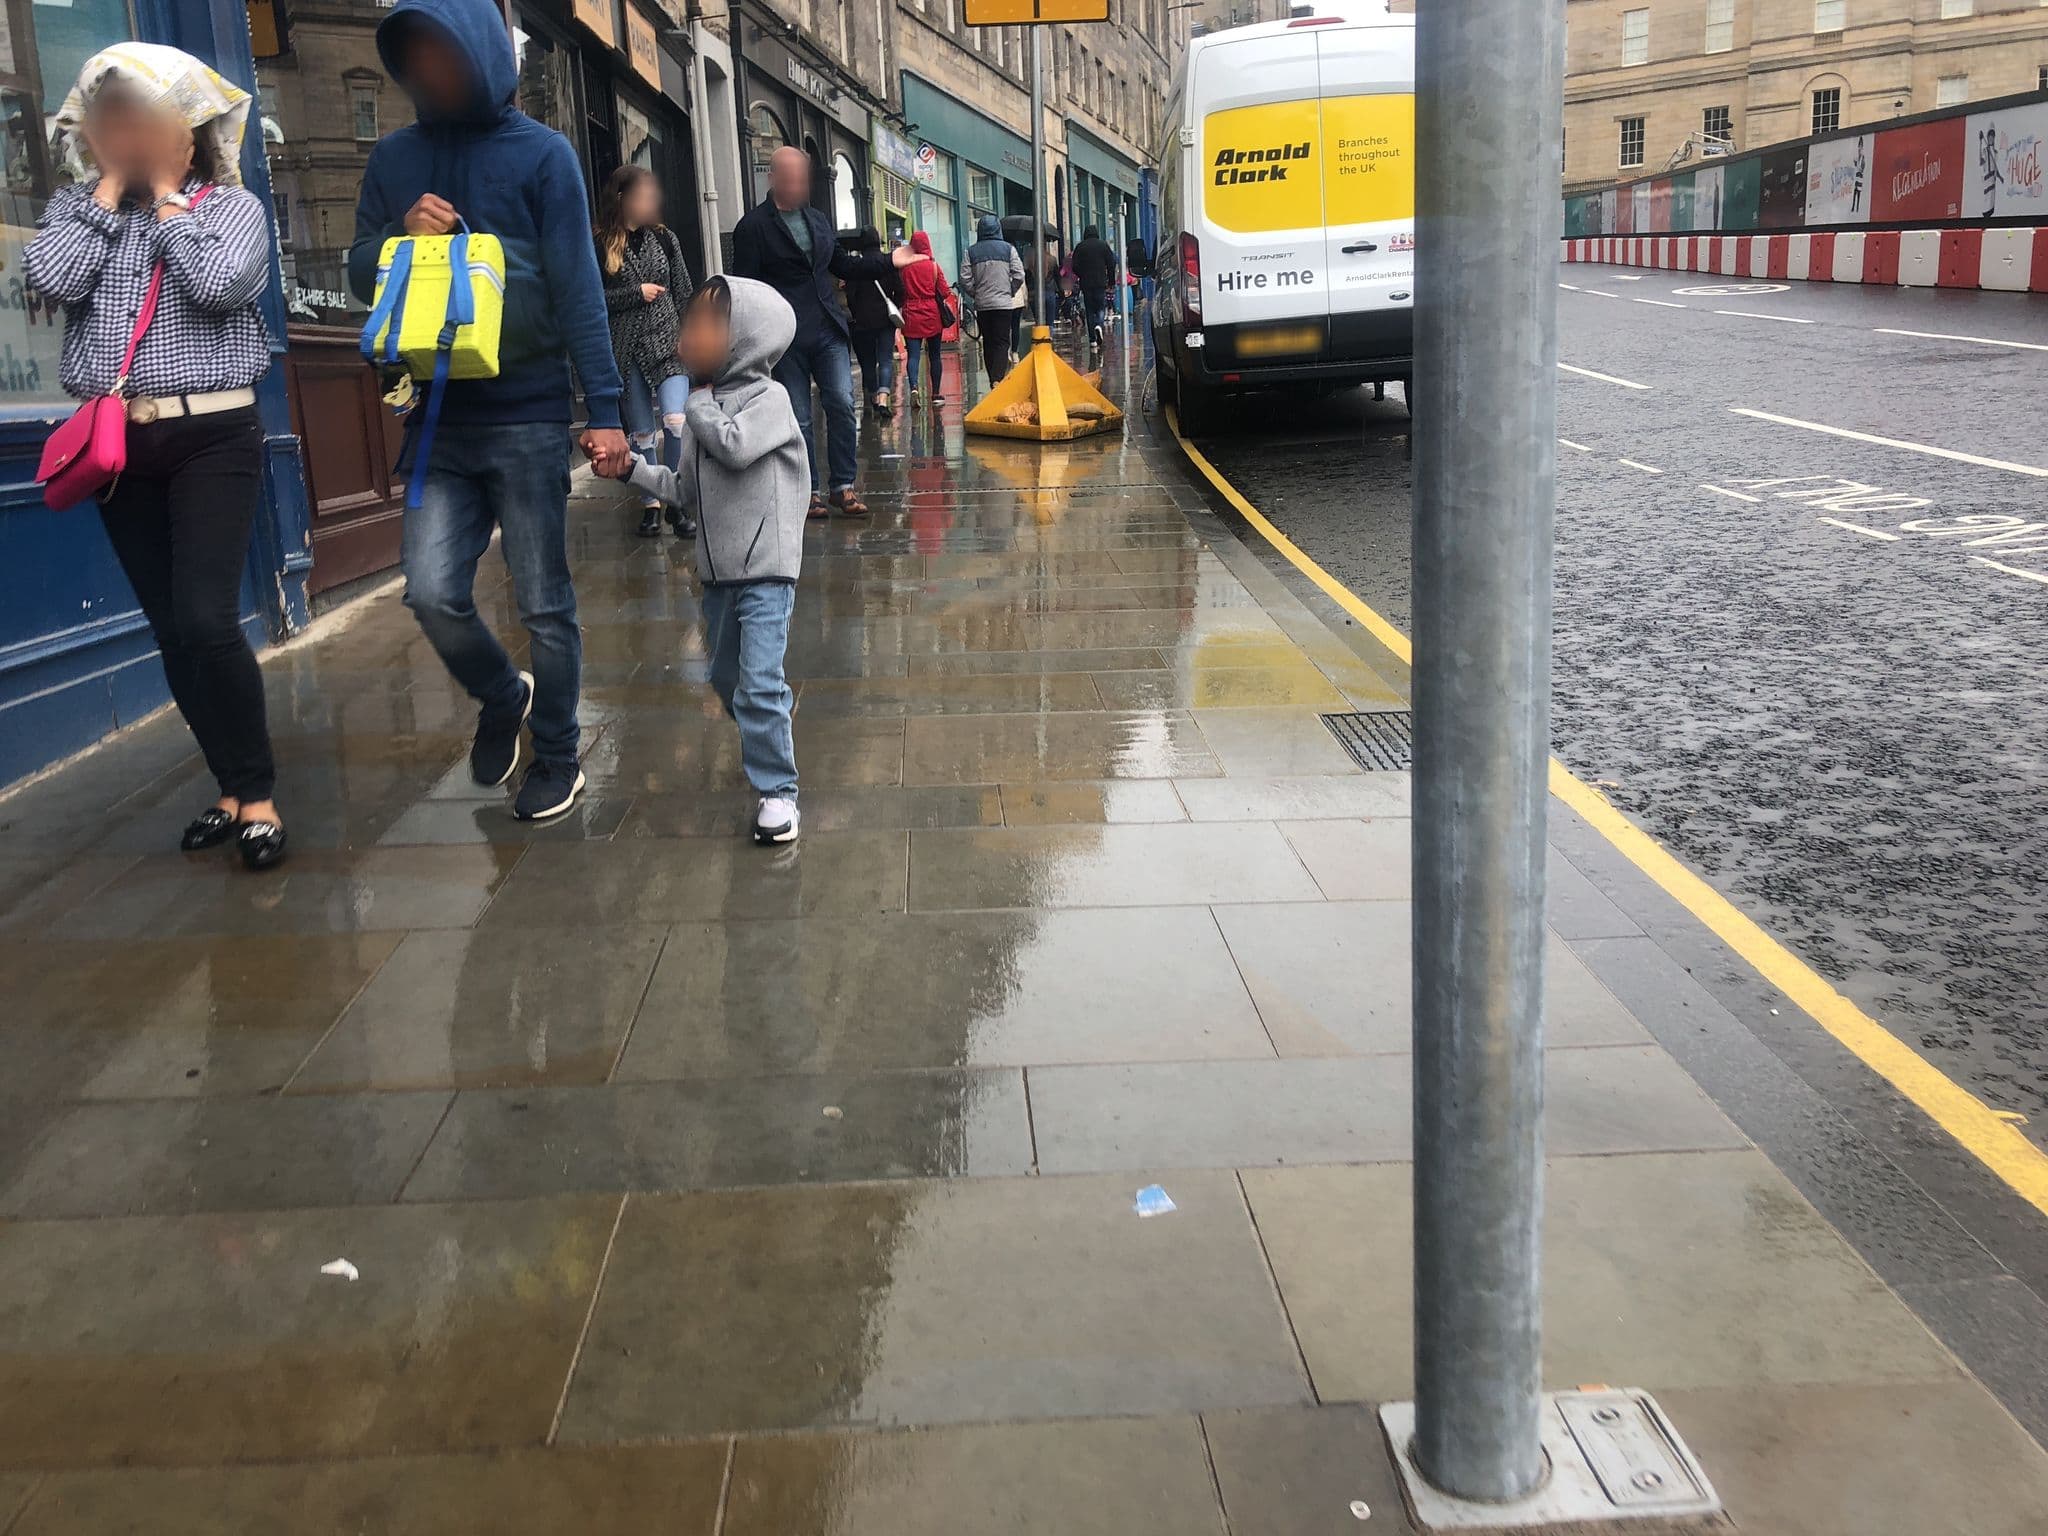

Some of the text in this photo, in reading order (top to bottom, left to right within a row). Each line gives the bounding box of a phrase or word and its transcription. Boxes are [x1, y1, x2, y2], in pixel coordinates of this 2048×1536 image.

[1338, 136, 1388, 149] Branches
[1214, 142, 1311, 166] Arnold
[1338, 148, 1400, 162] throughout
[1214, 164, 1288, 186] Clark
[1339, 163, 1376, 176] the UK
[1892, 151, 1941, 203] REGENERATION
[1240, 252, 1296, 262] TRANSIT
[1218, 269, 1315, 292] Hire me
[327, 290, 347, 309] SALE
